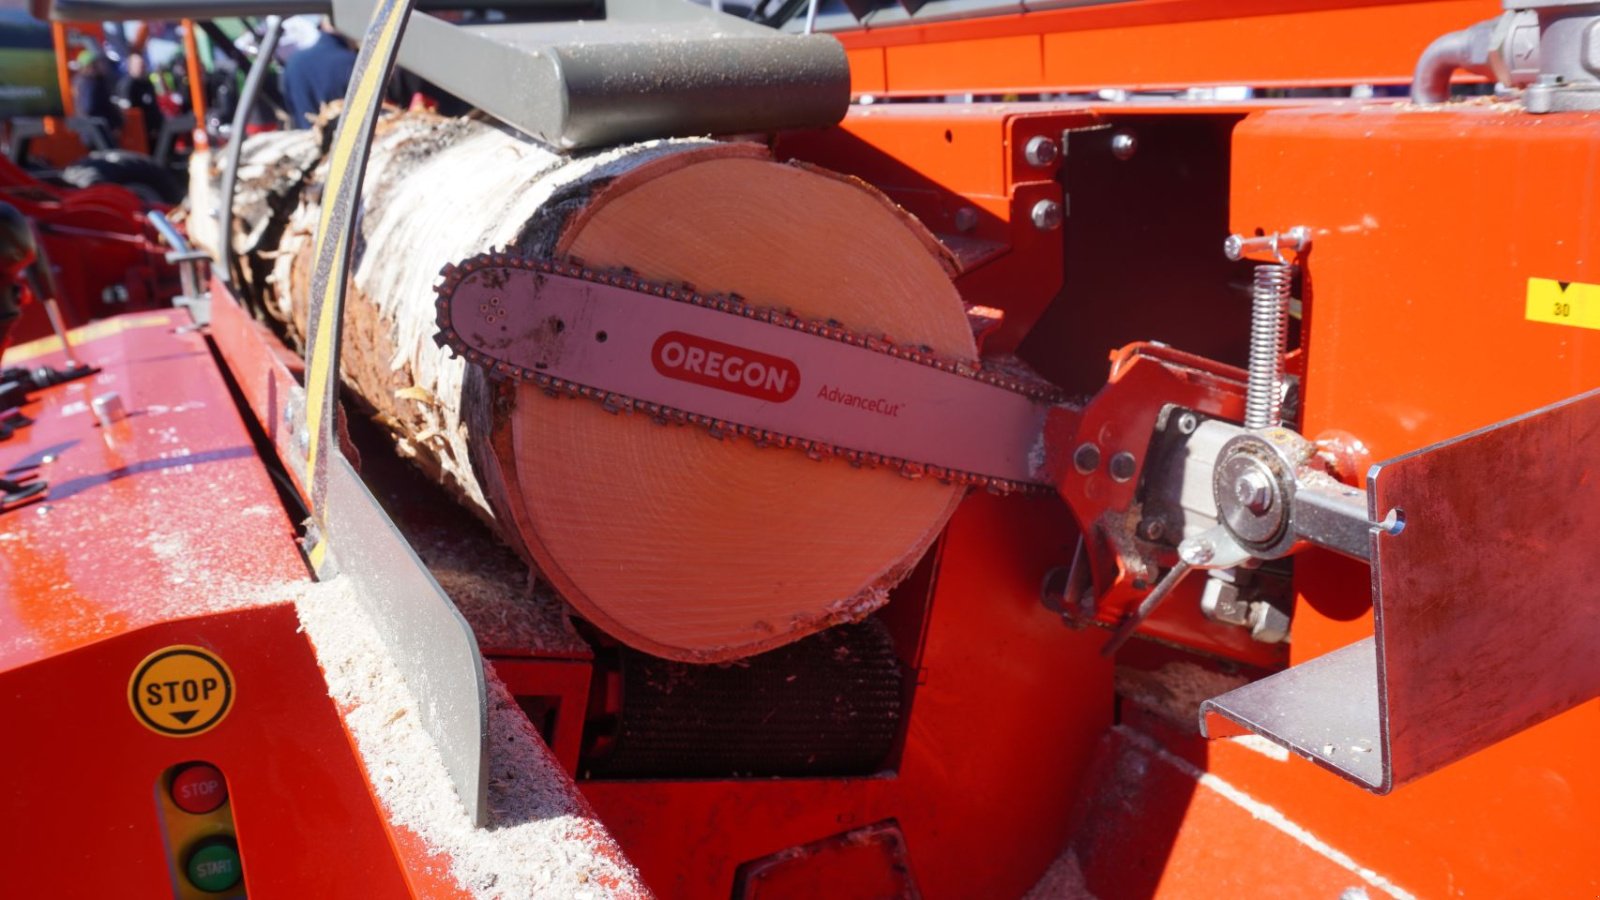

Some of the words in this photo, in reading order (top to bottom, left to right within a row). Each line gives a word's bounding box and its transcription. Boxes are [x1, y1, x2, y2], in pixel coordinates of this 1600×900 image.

[661, 341, 789, 393] OREGON
[817, 384, 900, 417] AdvanceCut
[146, 678, 218, 706] STOP
[180, 780, 219, 799] STOP
[196, 859, 232, 878] START
